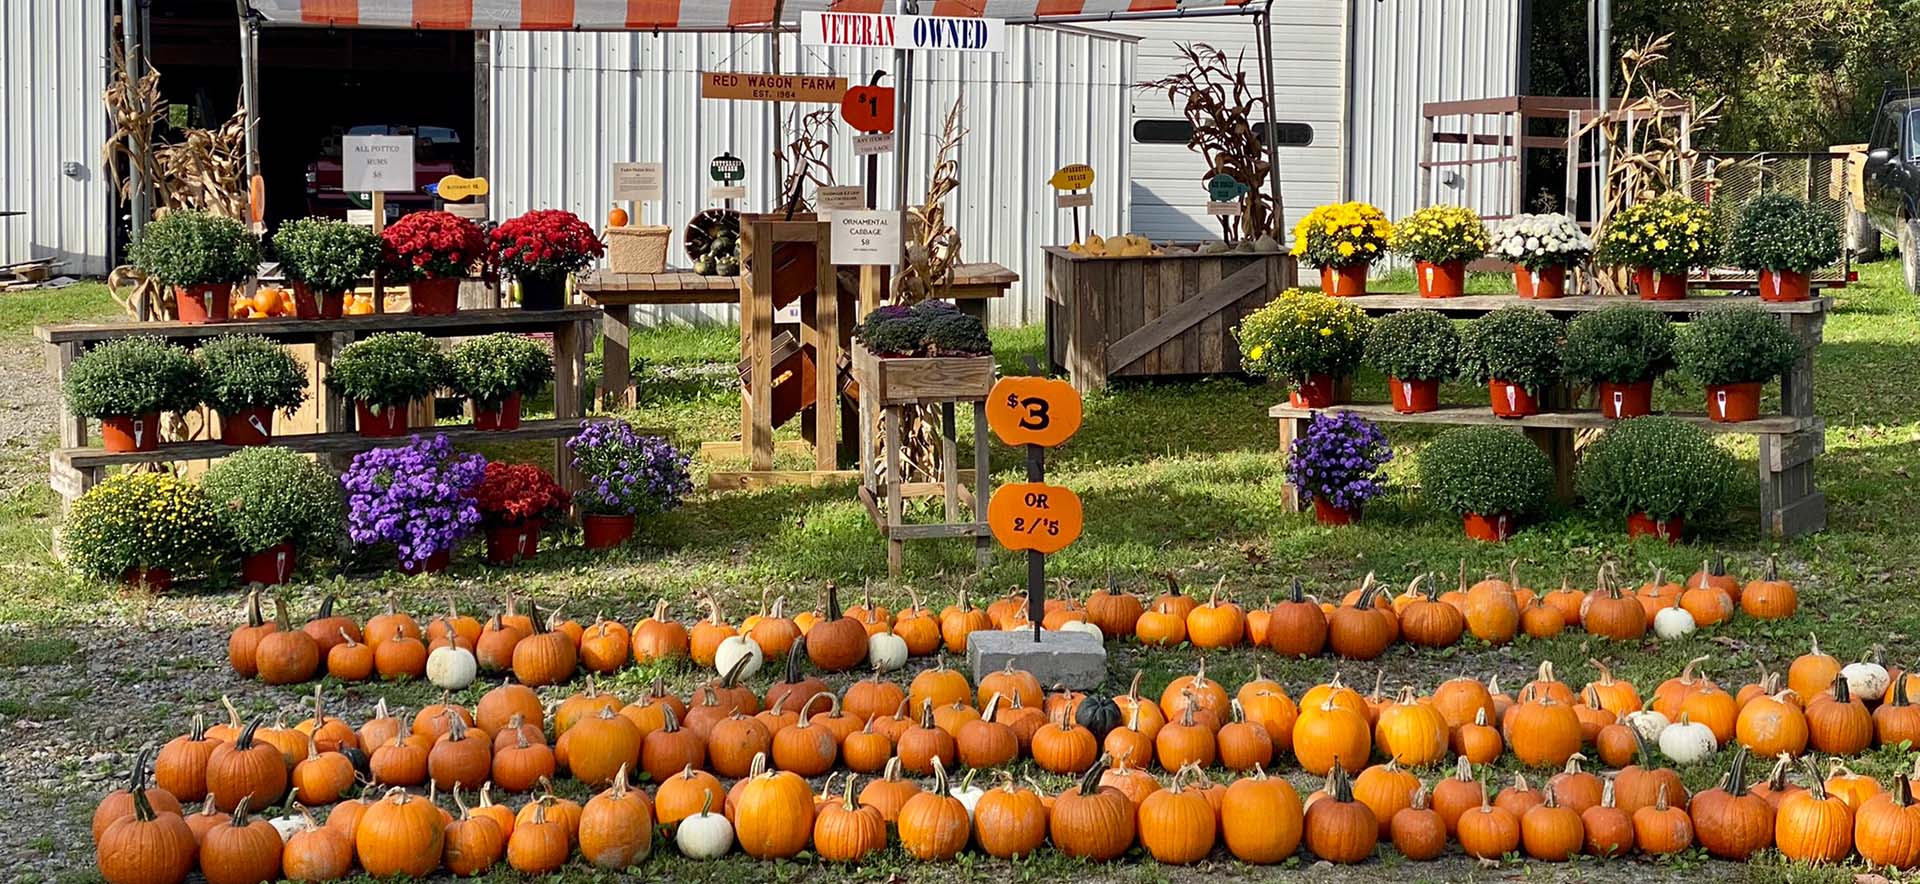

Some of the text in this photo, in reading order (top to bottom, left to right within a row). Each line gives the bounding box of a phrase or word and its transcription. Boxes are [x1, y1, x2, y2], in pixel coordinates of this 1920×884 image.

[821, 14, 988, 49] VETERAN OWNED
[712, 75, 836, 90] RED WAGON FARM
[753, 90, 772, 98] EST.
[858, 92, 877, 117] $1
[371, 145, 400, 153] POTTED
[842, 218, 889, 226] ORNAMENTAL
[849, 228, 882, 236] CABBAGE
[1007, 393, 1050, 431] $3
[1024, 493, 1050, 509] OR
